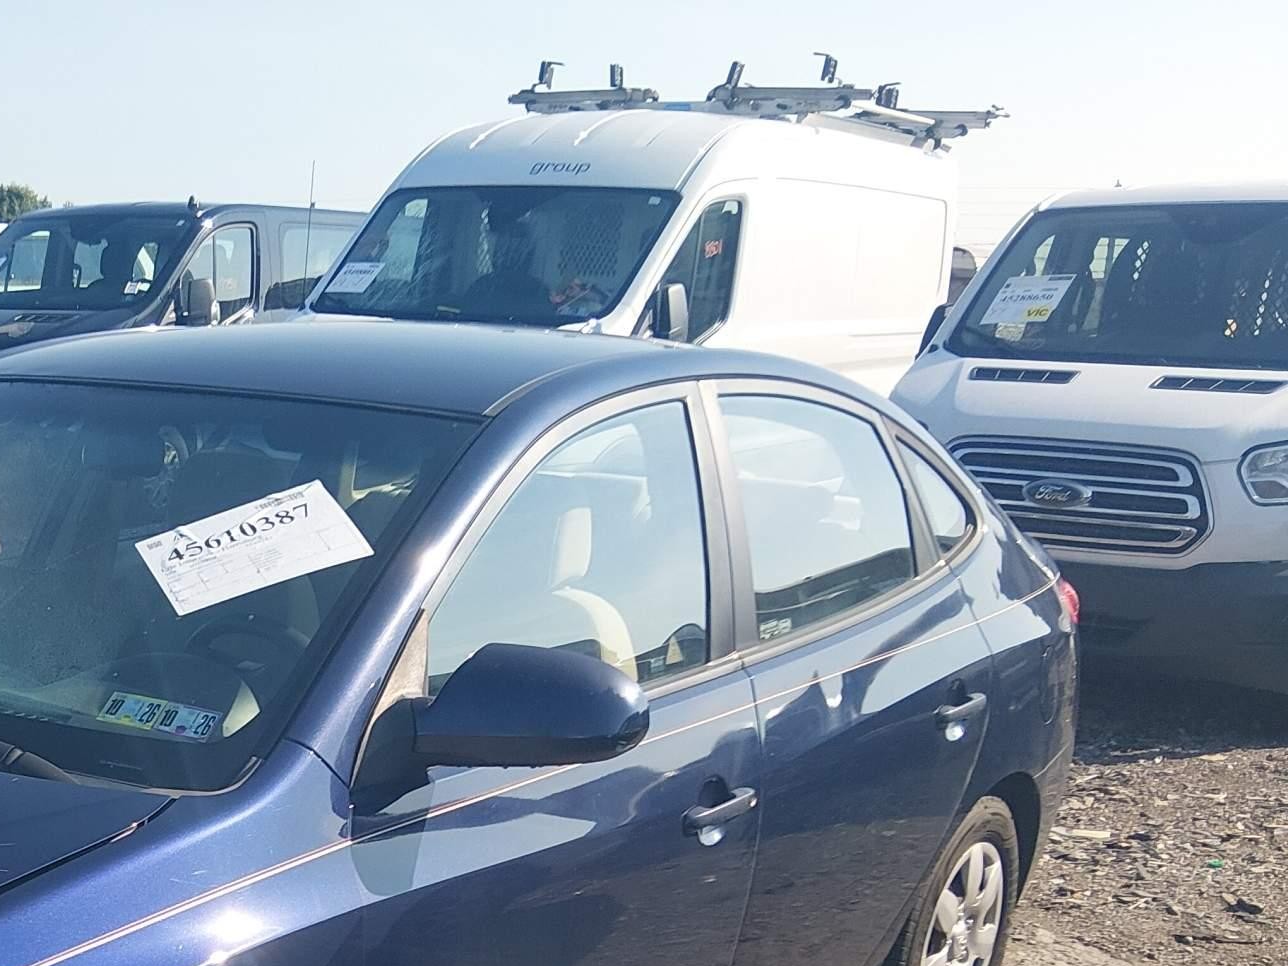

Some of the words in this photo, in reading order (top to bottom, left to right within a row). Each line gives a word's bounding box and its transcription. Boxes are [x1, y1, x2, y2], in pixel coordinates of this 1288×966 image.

[529, 162, 591, 176] group
[1026, 308, 1049, 318] VIC
[1035, 485, 1072, 501] Ford
[168, 502, 309, 561] 45610387
[105, 699, 125, 716] 10
[137, 702, 162, 724] 26
[159, 708, 179, 728] 10
[193, 714, 217, 736] 26
